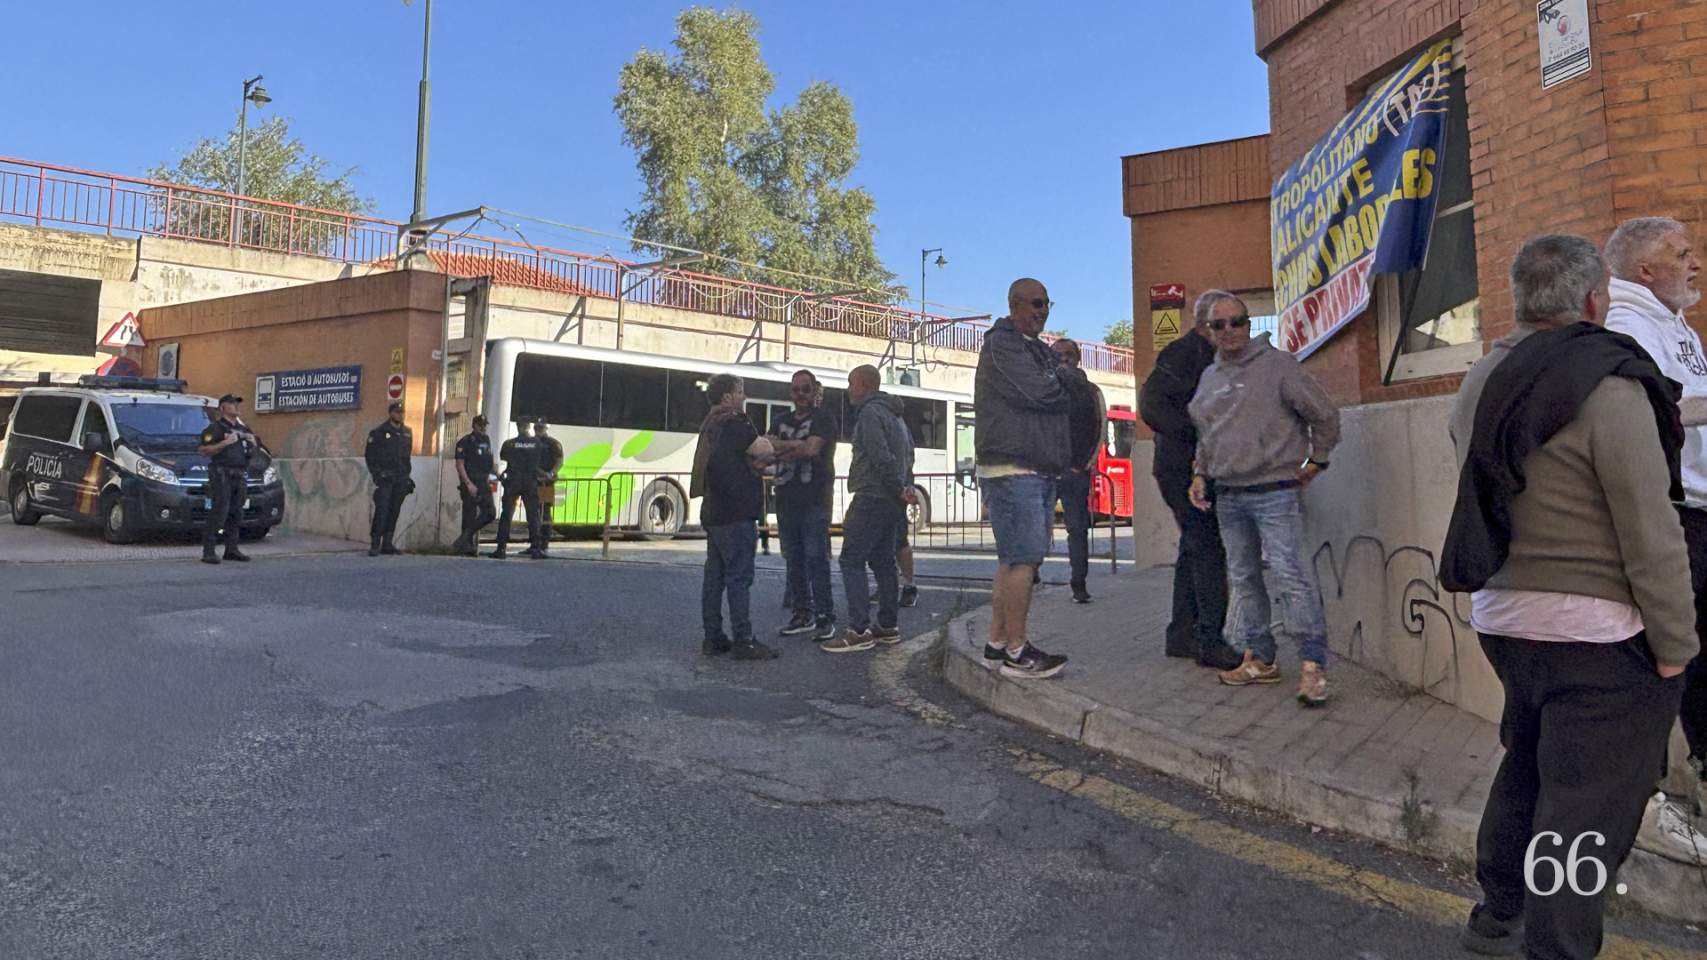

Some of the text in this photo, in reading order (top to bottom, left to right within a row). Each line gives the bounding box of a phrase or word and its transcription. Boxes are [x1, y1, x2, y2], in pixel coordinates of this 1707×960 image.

[1277, 158, 1375, 257] ALICANTE
[281, 374, 306, 388] ESTACIÓ
[279, 391, 354, 407] ESTACIÓN DE AUTOBUSES
[26, 455, 62, 478] POLICÍA
